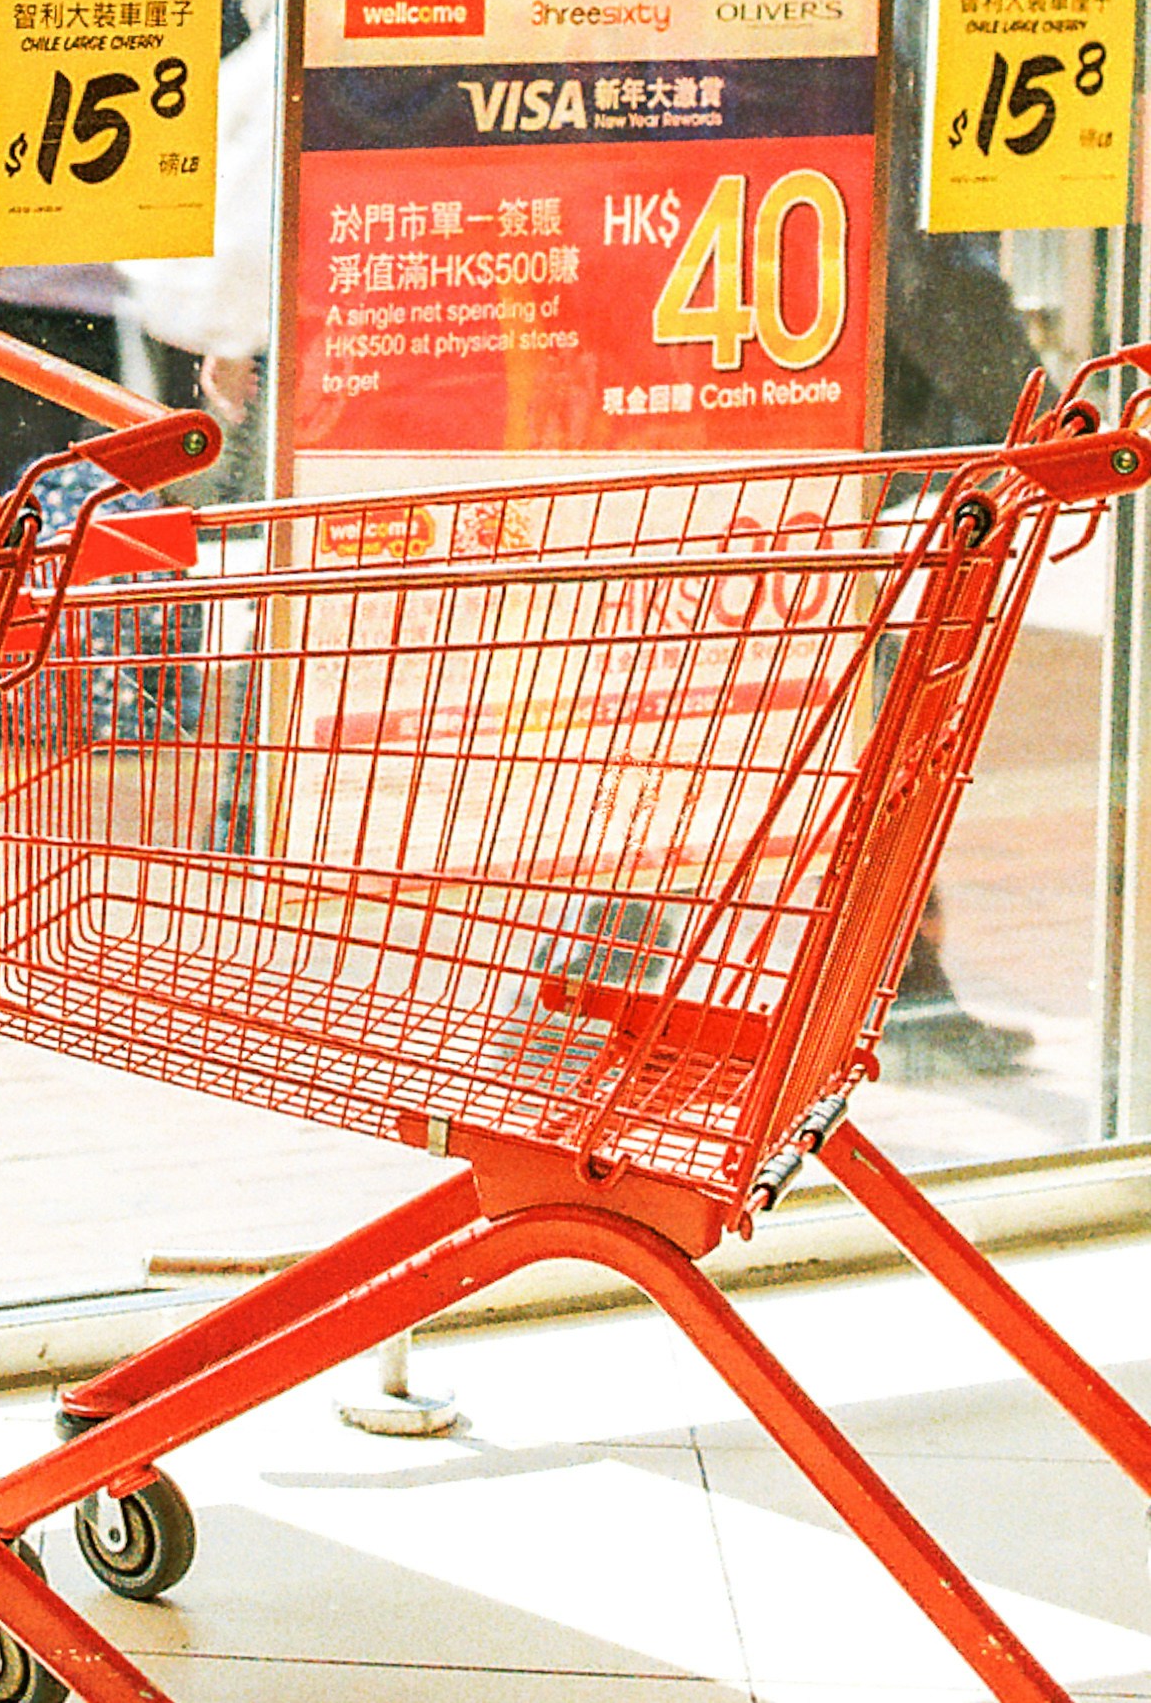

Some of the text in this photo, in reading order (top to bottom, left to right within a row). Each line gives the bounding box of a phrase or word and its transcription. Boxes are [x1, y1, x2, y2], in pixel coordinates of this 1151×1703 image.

[363, 0, 467, 27] wellcome
[716, 0, 844, 23] OLIVER'S
[21, 34, 164, 52] CHILE LARGE CHERRY
[457, 79, 588, 133] VISA
[594, 75, 725, 111] 新年大激賞
[594, 110, 723, 130] New Year Rewards
[325, 294, 560, 331] A single net spending of
[325, 328, 580, 359] HK$500 at physical stores
[321, 370, 381, 397] to get
[699, 381, 757, 410] Cash
[761, 376, 842, 406] Rebate
[329, 518, 419, 540] welcome
